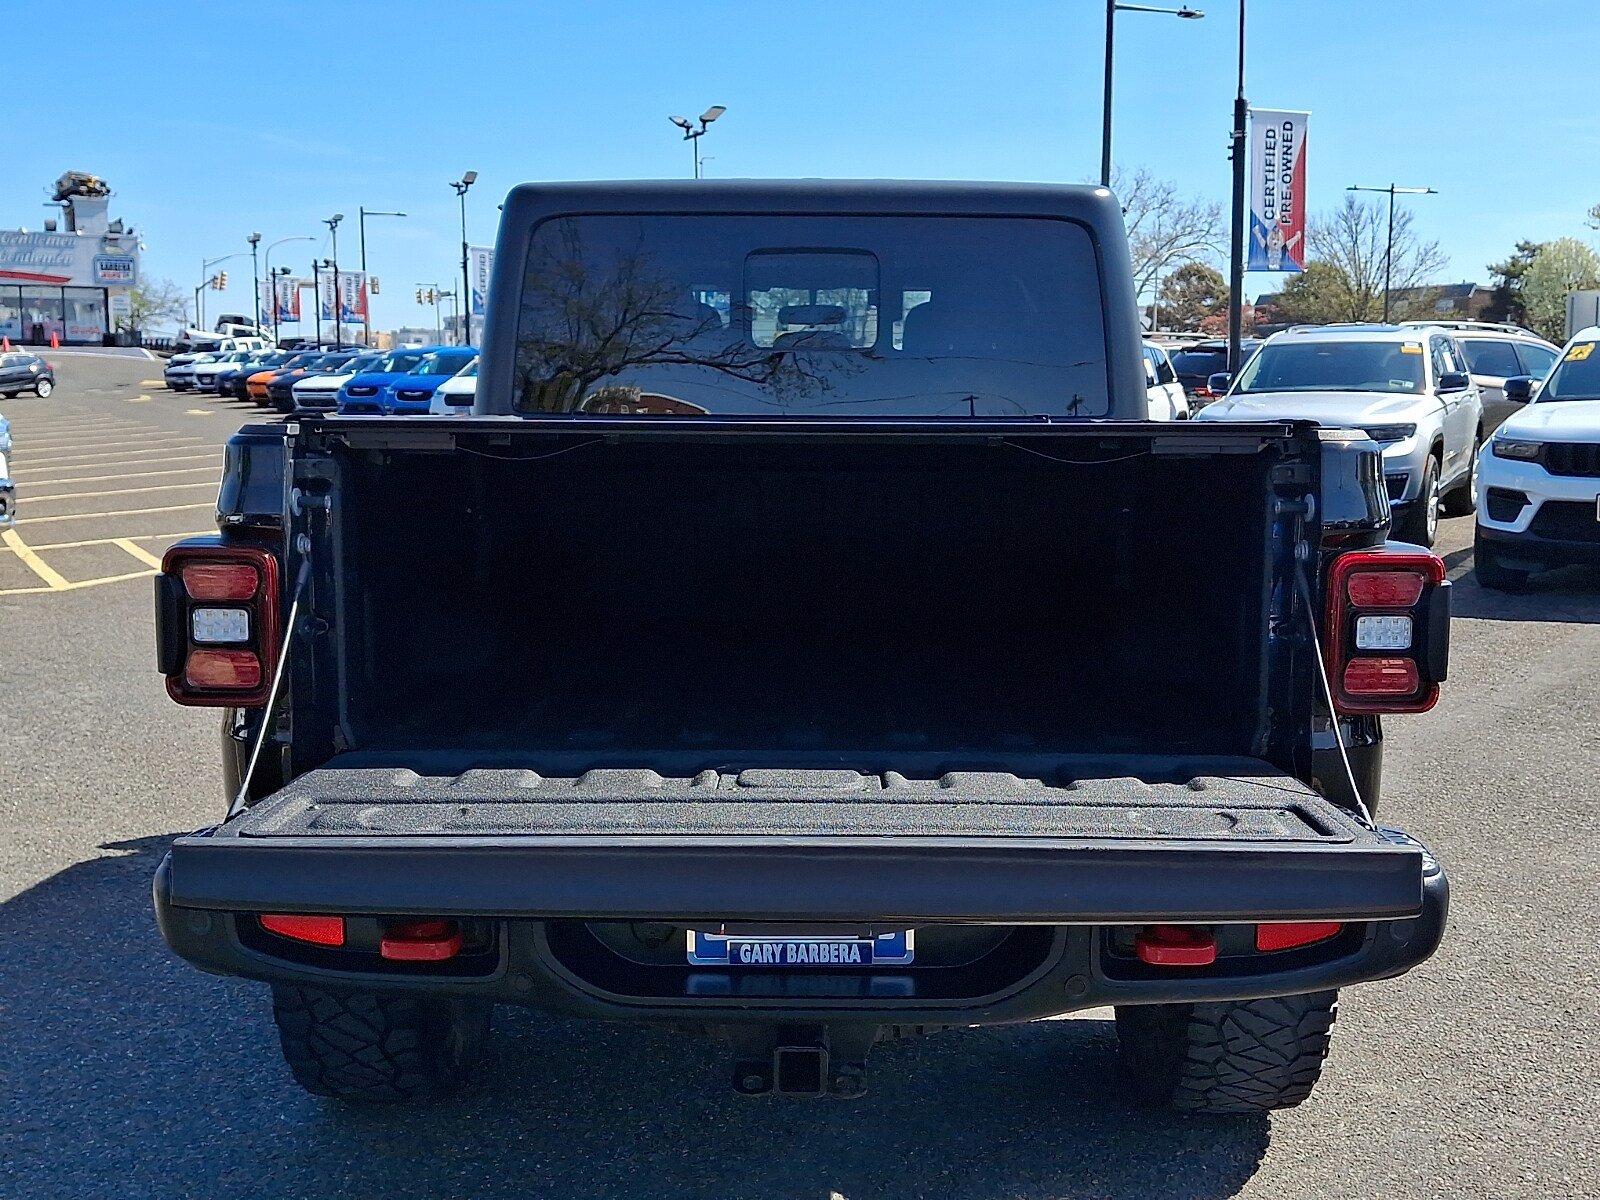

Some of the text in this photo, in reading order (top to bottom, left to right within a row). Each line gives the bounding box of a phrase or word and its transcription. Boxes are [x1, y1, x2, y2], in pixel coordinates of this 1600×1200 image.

[1264, 128, 1276, 221] CERTIFIED
[1280, 120, 1294, 224] PRE-OWNED
[479, 254, 487, 293] CERTIFIED
[739, 943, 862, 963] GARY BARBERA
